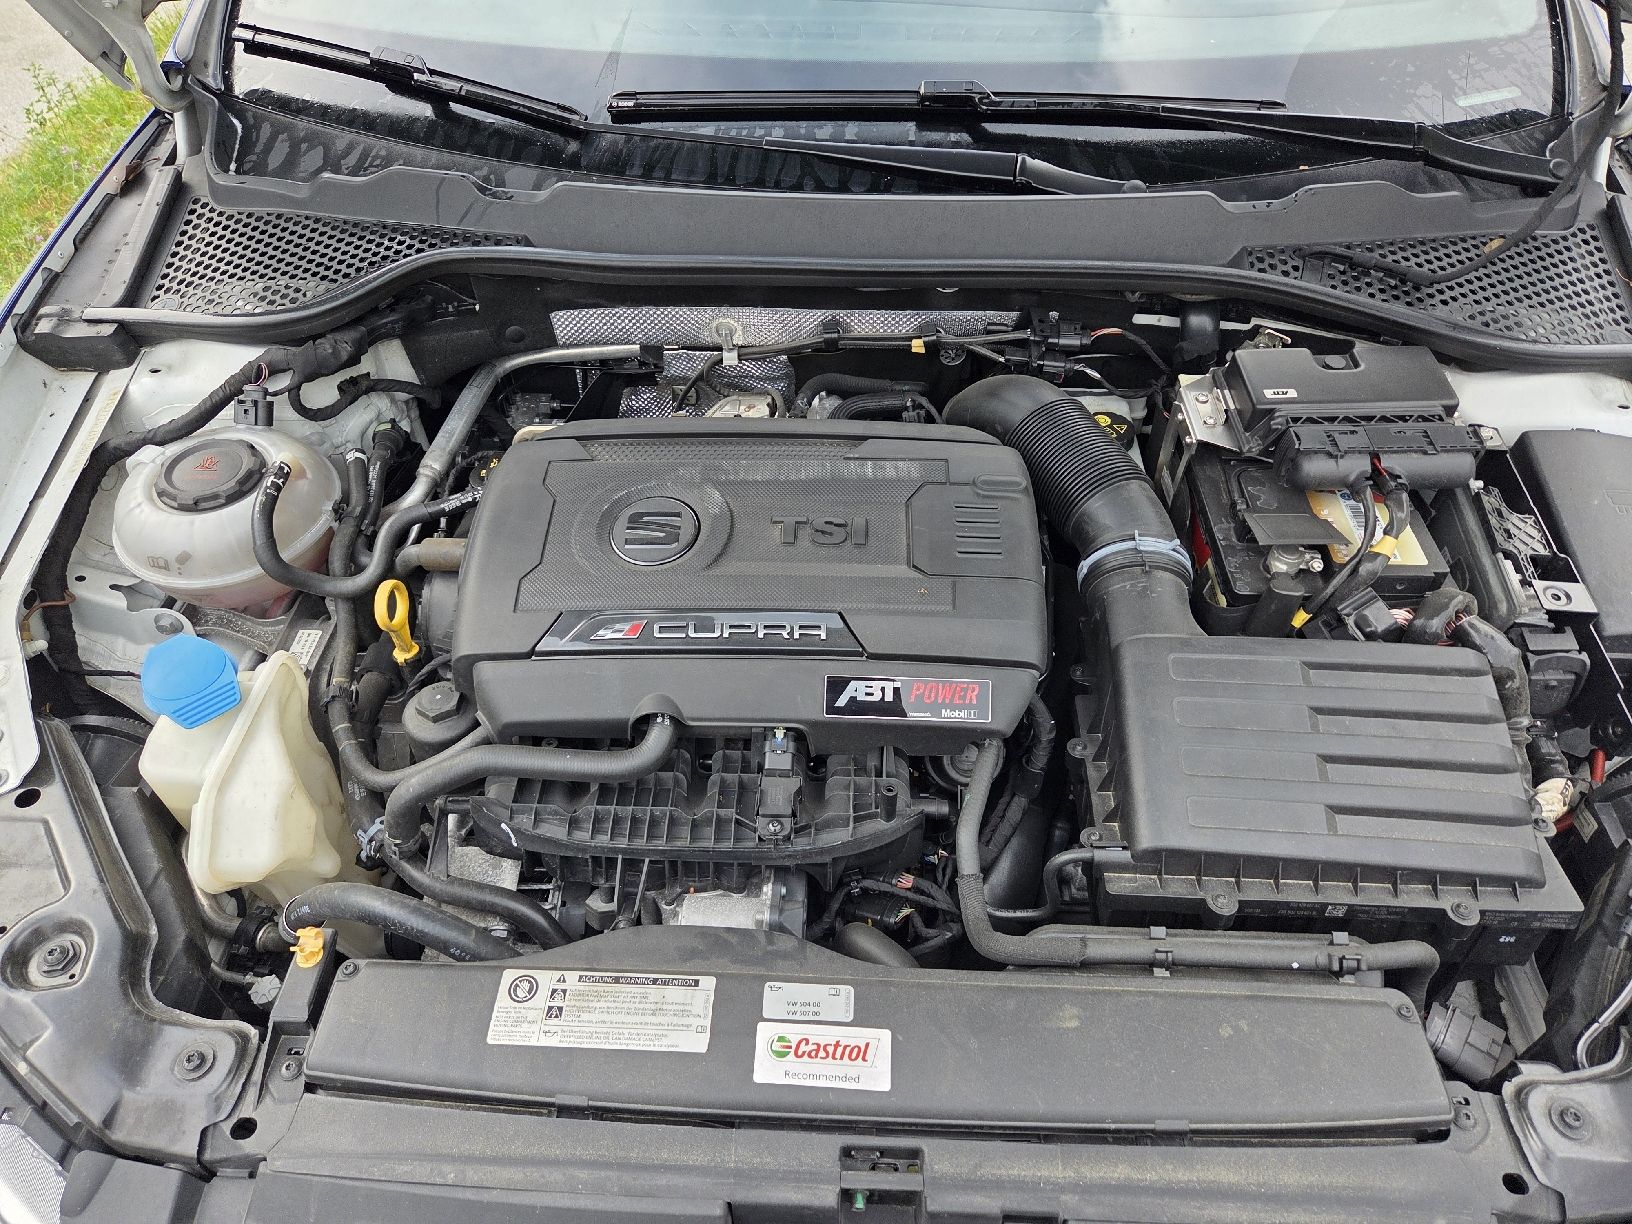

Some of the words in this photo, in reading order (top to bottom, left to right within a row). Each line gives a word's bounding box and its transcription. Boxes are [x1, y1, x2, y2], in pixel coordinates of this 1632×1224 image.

[771, 516, 868, 546] TSI
[653, 621, 827, 640] CUPRA
[834, 680, 901, 707] ABT
[909, 682, 980, 705] POWER
[941, 708, 967, 719] Mobil
[580, 975, 615, 984] ACHTUNG
[619, 977, 653, 985] WARNING
[656, 978, 695, 987] ATTENTION
[793, 1037, 870, 1063] Castrol
[784, 1070, 860, 1084] Recommended
